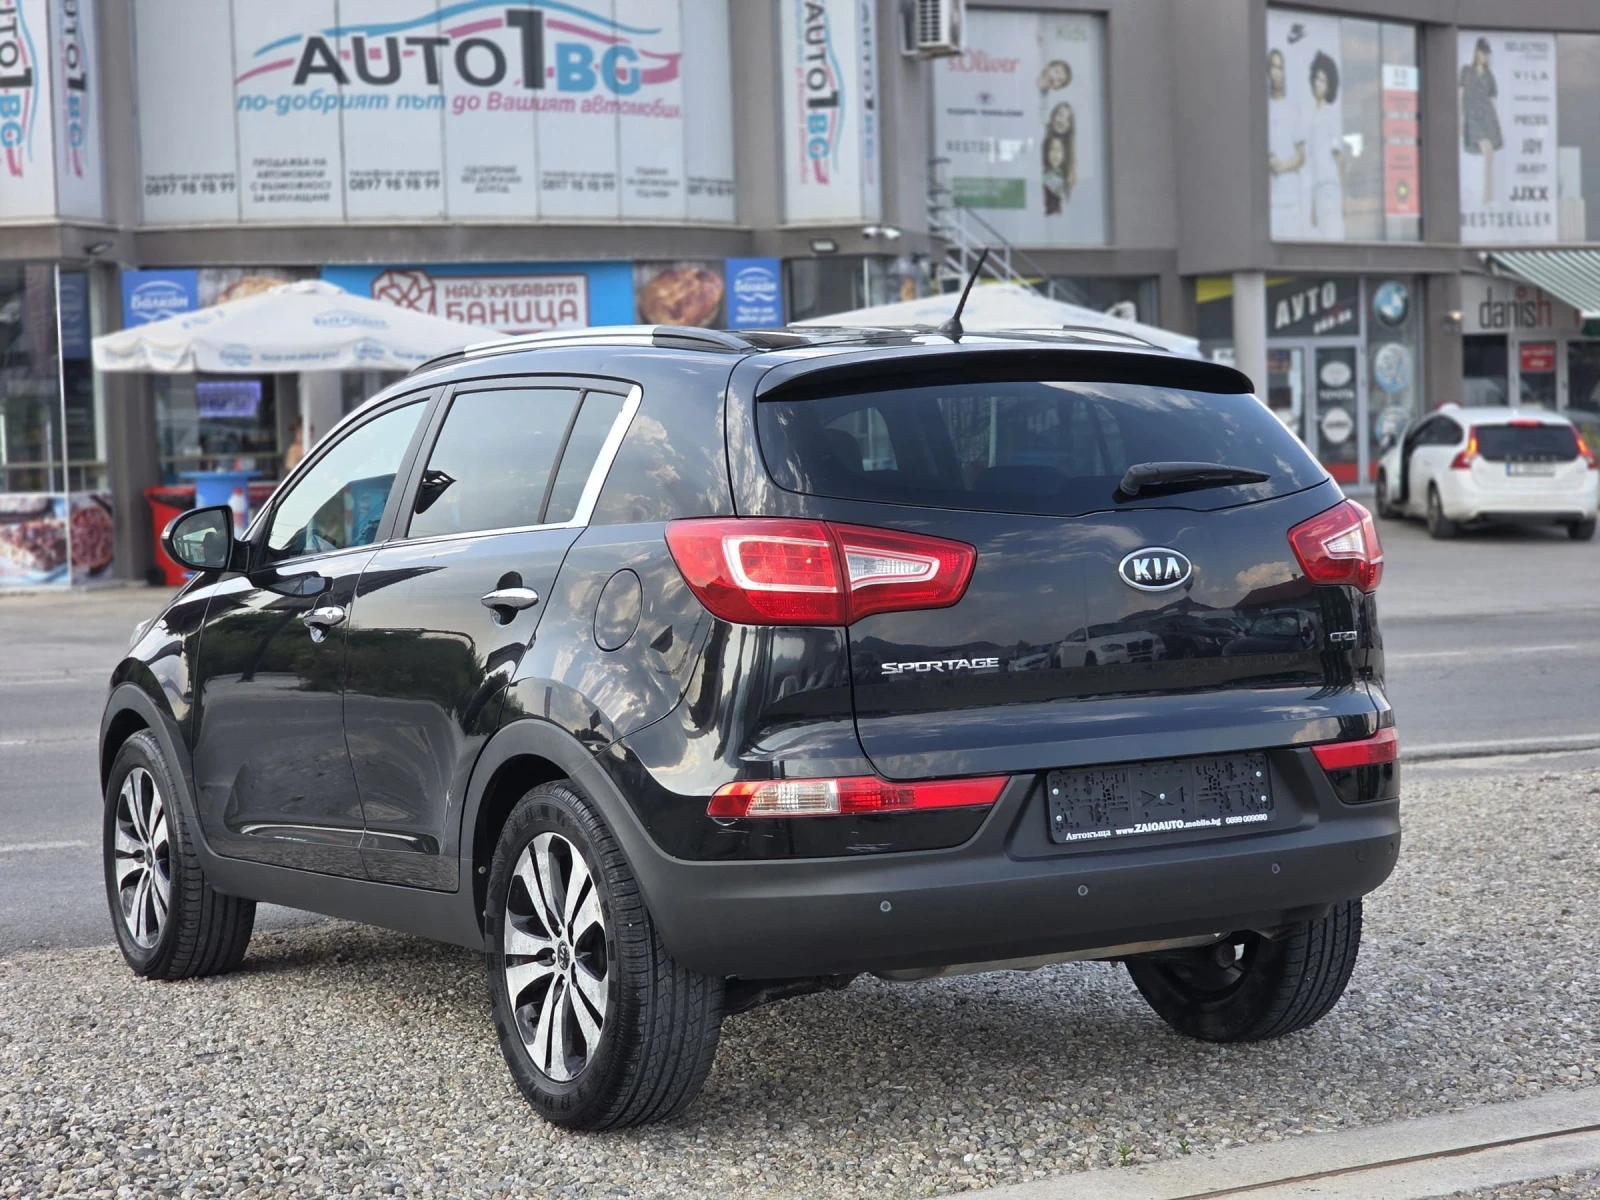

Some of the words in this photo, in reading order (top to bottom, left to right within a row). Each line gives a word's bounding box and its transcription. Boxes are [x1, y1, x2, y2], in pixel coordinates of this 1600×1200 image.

[292, 8, 641, 95] AUTO1BG
[804, 2, 839, 161] AUTO1BG
[237, 88, 389, 116] по-добрият
[396, 93, 446, 110] път
[452, 94, 481, 116] до
[486, 91, 576, 113] Вашият
[1509, 185, 1549, 202] JJXX
[1459, 210, 1552, 228] BESTSELLER
[445, 280, 578, 299] НАЙ-ХУБАВАТА
[445, 298, 579, 327] БАНИЦА
[1132, 556, 1182, 581] KIA
[881, 657, 1000, 675] SPORTAGE
[1066, 829, 1112, 842] Автокъща
